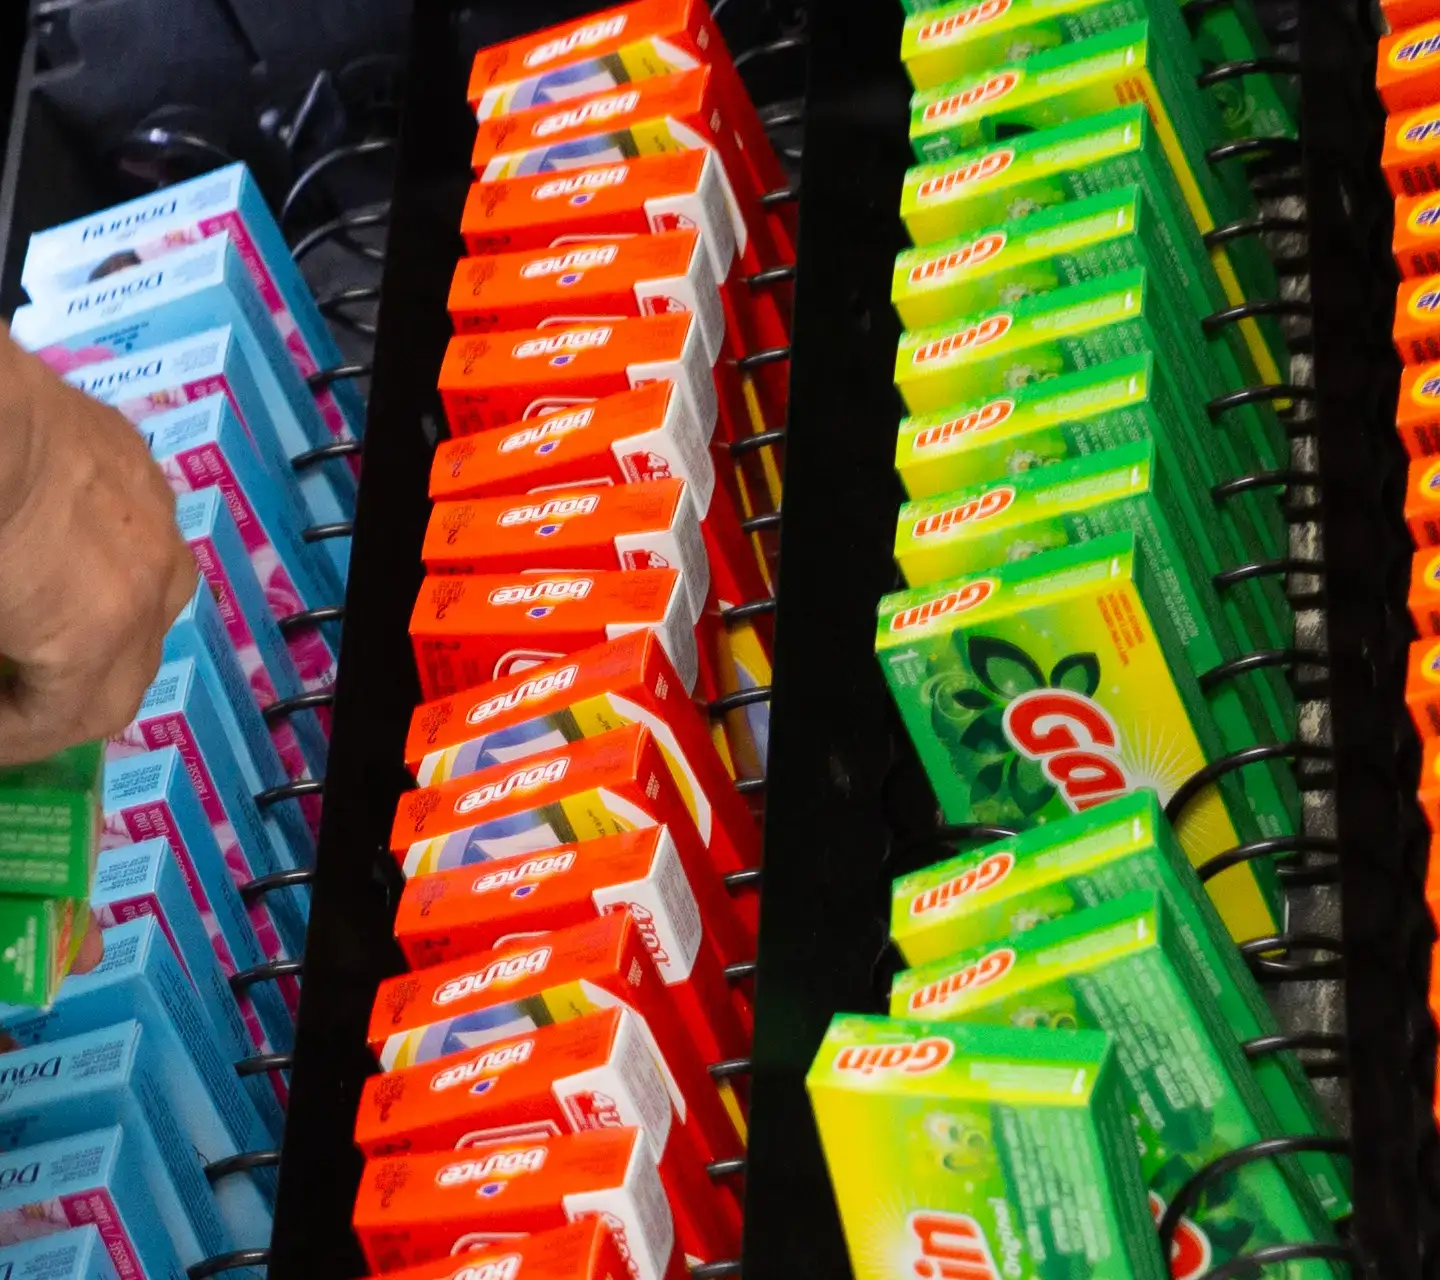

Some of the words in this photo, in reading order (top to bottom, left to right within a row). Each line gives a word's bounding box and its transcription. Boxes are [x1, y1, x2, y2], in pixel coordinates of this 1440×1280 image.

[526, 17, 625, 65] bounce
[535, 93, 637, 134] bounce
[925, 74, 1016, 120] Gain
[535, 167, 627, 198] bounce
[919, 152, 1013, 199] Gain
[81, 199, 177, 244] Downy
[523, 247, 617, 277] bounce
[911, 236, 1005, 283] Gain
[67, 272, 164, 316] Downy
[515, 328, 611, 356] bounce
[916, 315, 1011, 363] Gain
[78, 359, 163, 393] Down
[500, 411, 592, 450] bounce
[914, 402, 1014, 449] Gain
[499, 497, 597, 526] bounce
[915, 489, 1014, 538] Gain
[491, 579, 592, 605] bounce
[892, 582, 993, 631] Gain
[468, 667, 576, 723] bounce
[1007, 690, 1128, 811] Ga
[456, 759, 567, 813] bounce
[474, 852, 575, 891] bounce
[912, 854, 1014, 914] Gain
[435, 949, 550, 1002] bounce
[910, 949, 1014, 1010] Gain
[434, 1042, 532, 1088] bounce
[835, 1039, 953, 1074] Gain
[438, 1148, 547, 1184] bounce
[905, 1208, 1000, 1280] in
